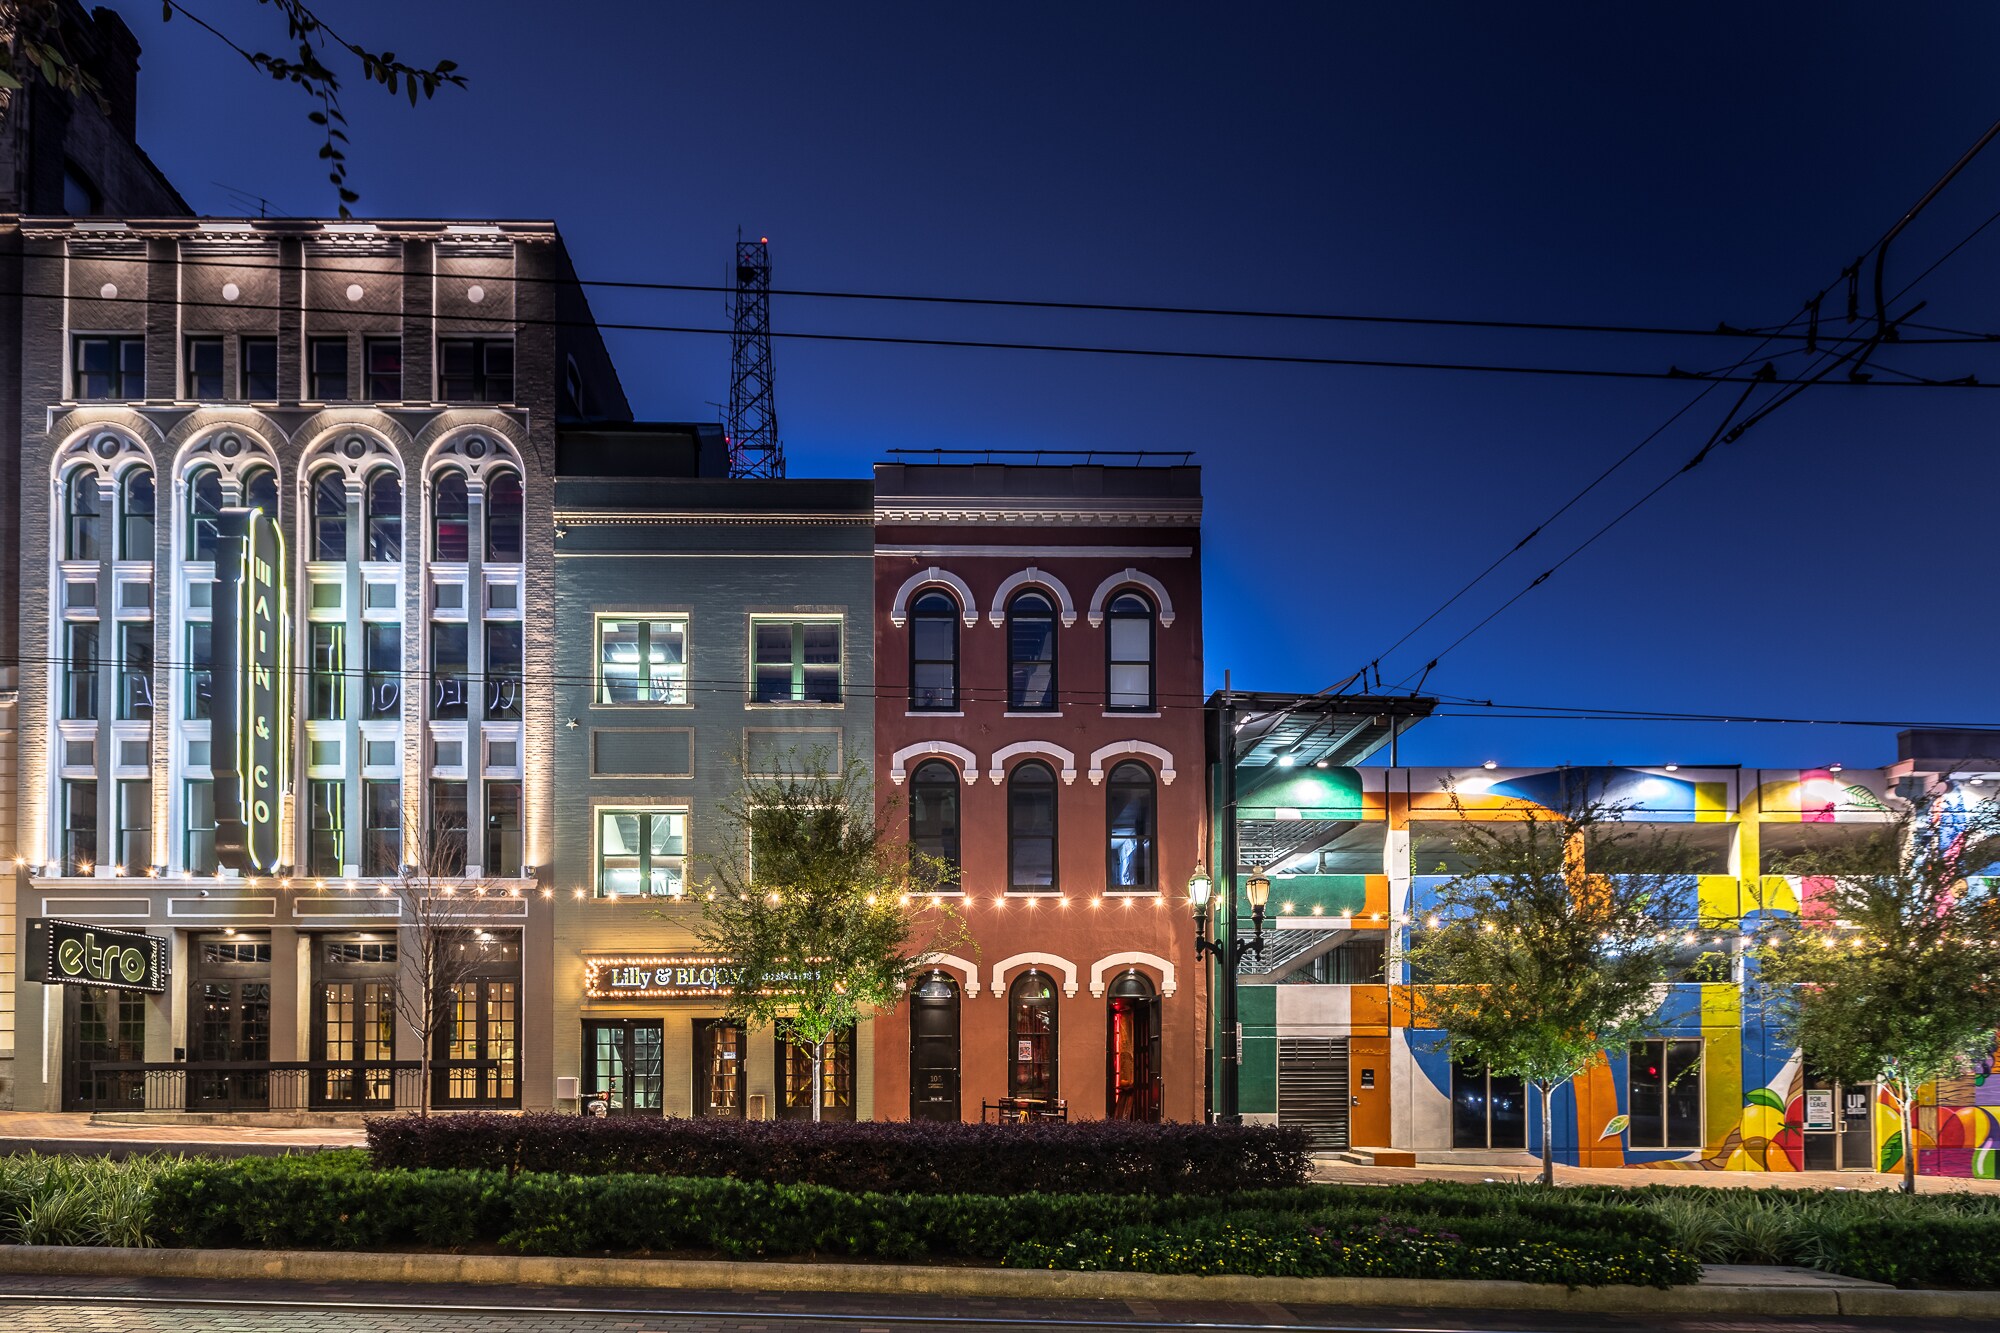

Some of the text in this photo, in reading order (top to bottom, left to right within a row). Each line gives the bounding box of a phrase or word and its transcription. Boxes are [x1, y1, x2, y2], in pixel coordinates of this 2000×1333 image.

[254, 556, 271, 824] MAIN & CO
[58, 932, 146, 983] etro
[611, 967, 652, 990] Lilly
[655, 968, 672, 986] &
[717, 1108, 730, 1116] 110
[1847, 1094, 1866, 1108] UP
